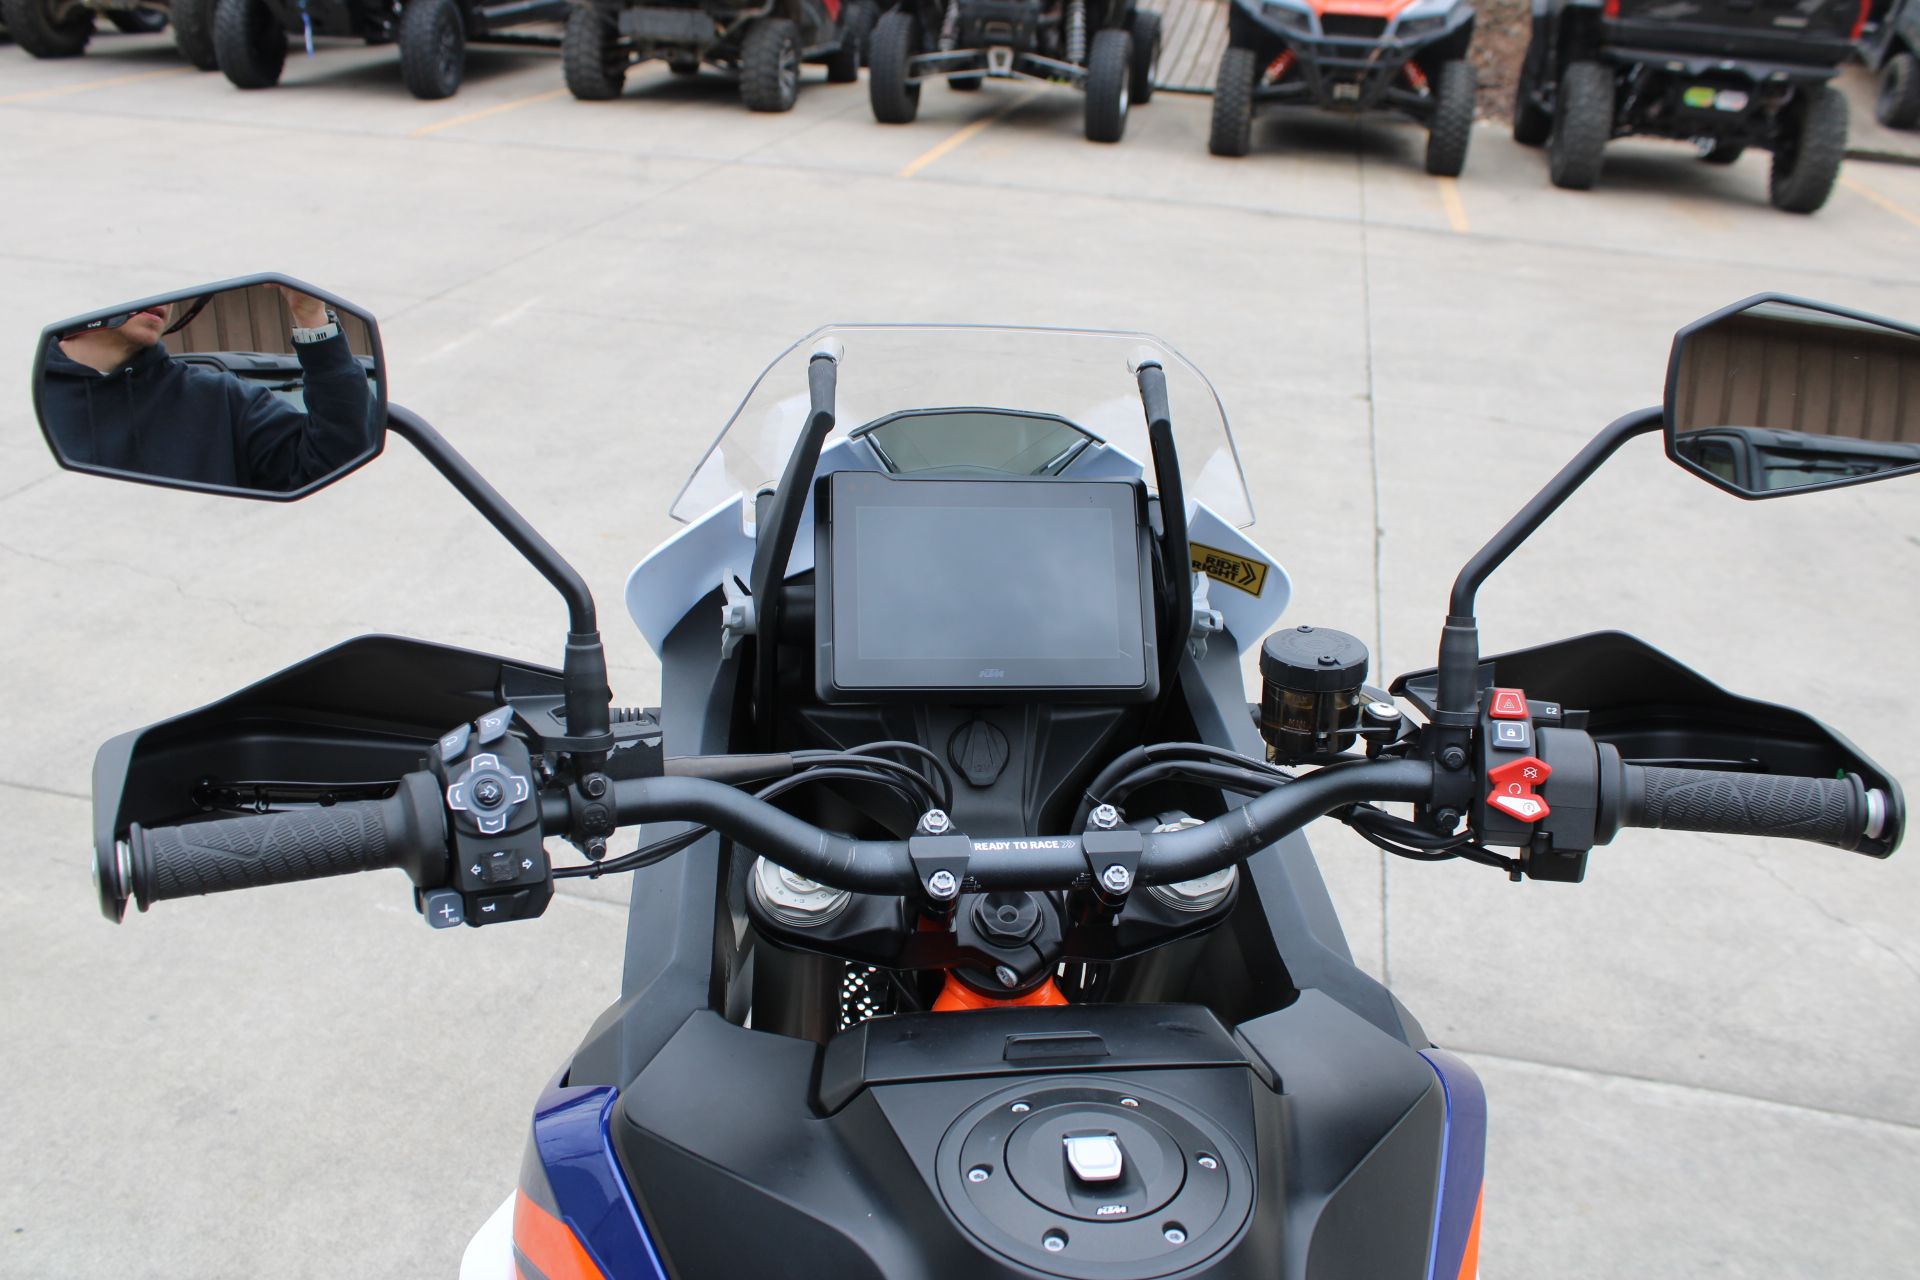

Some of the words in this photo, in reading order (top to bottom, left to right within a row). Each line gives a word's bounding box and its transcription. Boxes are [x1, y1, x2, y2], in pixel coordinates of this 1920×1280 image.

[1205, 553, 1241, 572] RIDE
[1191, 560, 1240, 580] RIGHT
[1545, 706, 1558, 715] C2
[973, 841, 1010, 851] READY
[1012, 841, 1028, 850] TO
[1029, 840, 1060, 849] RACE
[1096, 1204, 1127, 1216] KTM
